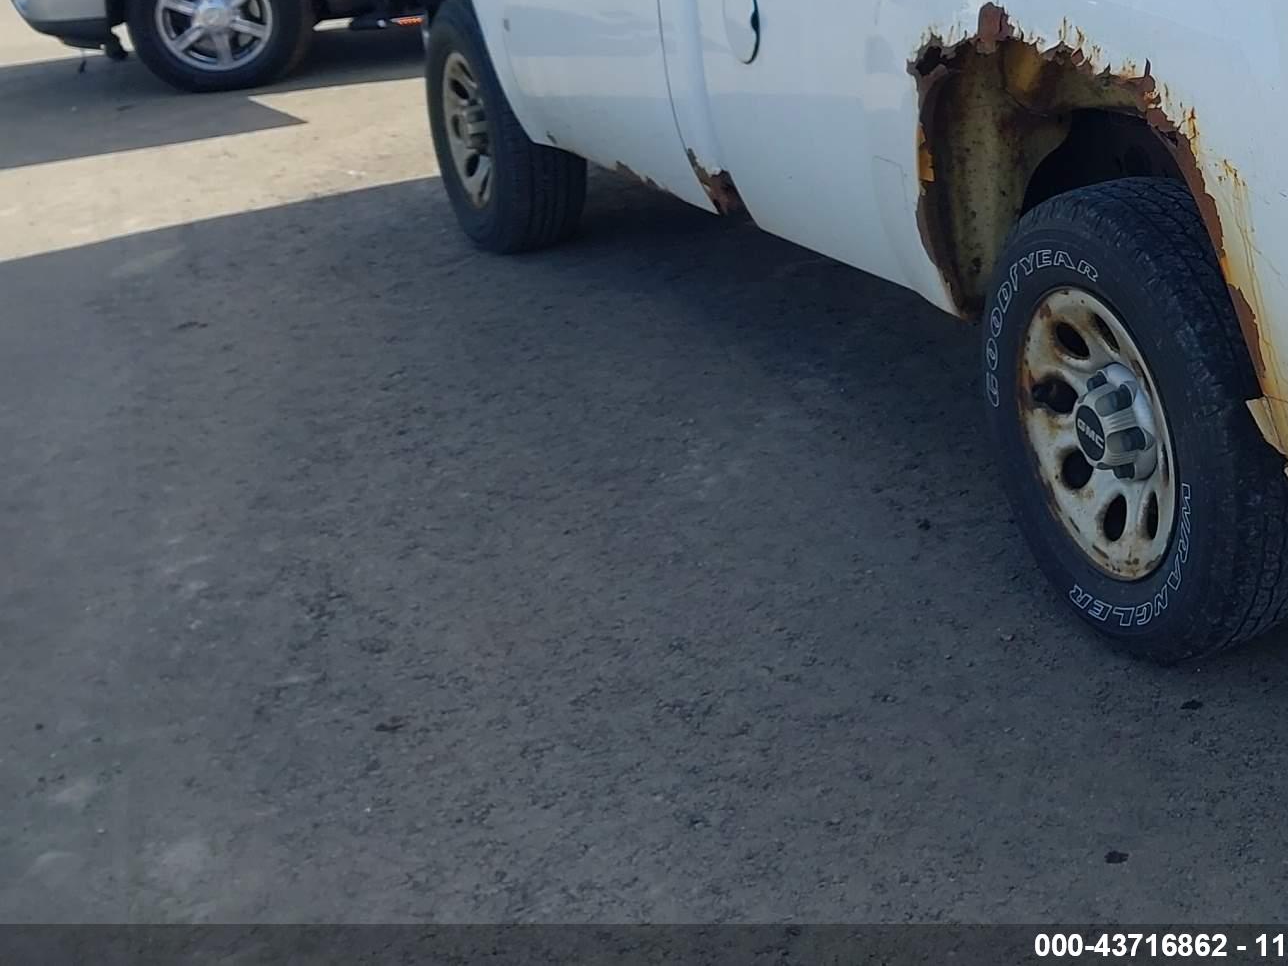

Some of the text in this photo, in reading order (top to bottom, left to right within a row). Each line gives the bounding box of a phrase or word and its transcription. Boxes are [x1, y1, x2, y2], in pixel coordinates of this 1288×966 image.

[986, 249, 1099, 408] GOODYEAR
[1077, 417, 1105, 449] GMC
[1069, 483, 1191, 626] WRANGLER
